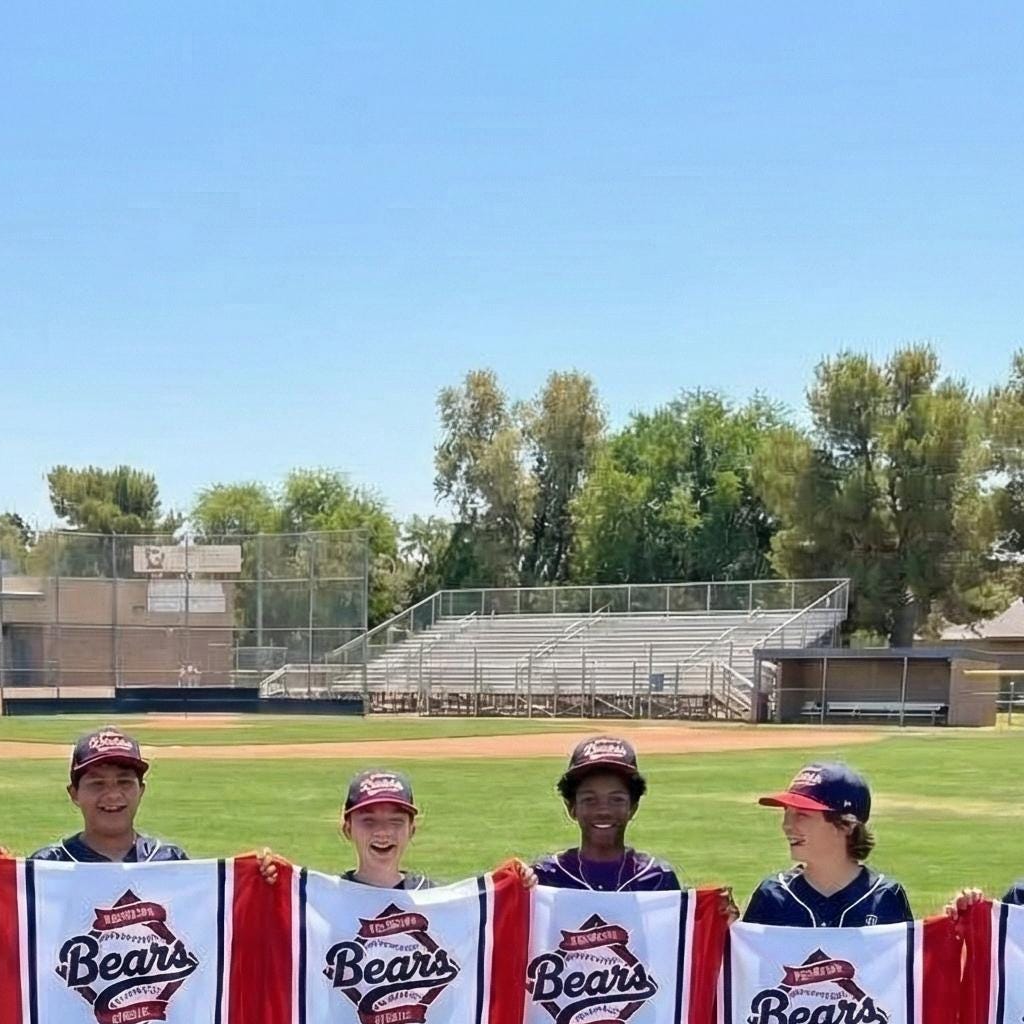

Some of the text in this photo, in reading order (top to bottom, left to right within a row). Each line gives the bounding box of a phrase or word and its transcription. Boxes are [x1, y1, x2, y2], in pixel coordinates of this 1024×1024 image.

[59, 935, 197, 987] Bears
[326, 941, 457, 989] Bears
[528, 953, 656, 1001] Bears
